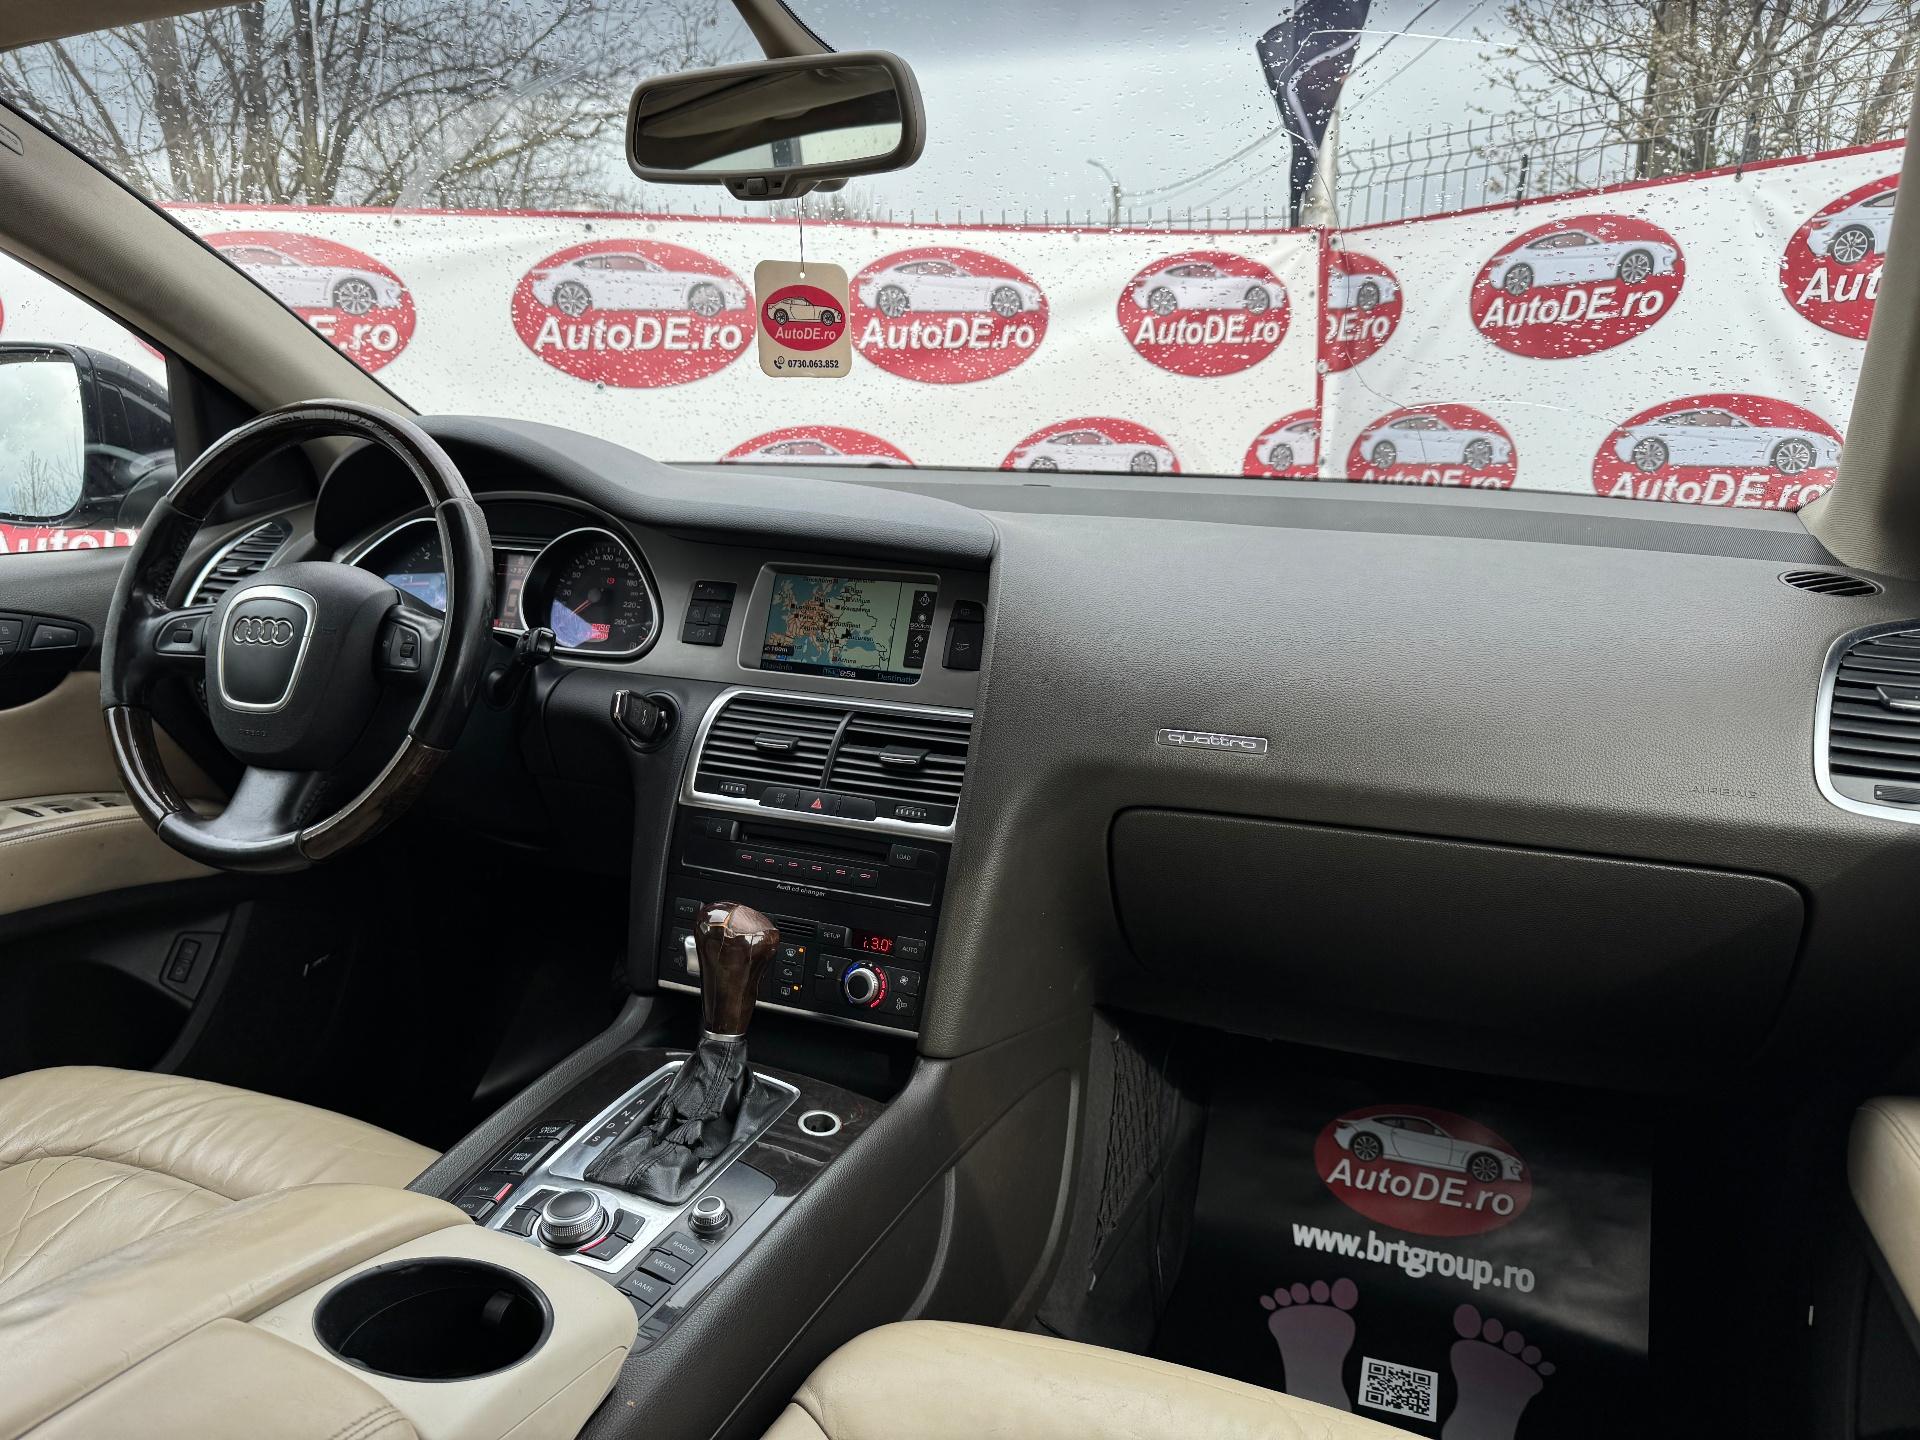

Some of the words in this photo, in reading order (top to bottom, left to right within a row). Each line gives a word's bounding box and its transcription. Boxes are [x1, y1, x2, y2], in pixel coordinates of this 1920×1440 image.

[1480, 286, 1664, 328] AutoDE.ro
[534, 316, 743, 351] AutoDE.ro
[775, 326, 837, 340] AutoDE.ro
[859, 317, 1035, 350] AutoDE.ro
[1133, 315, 1280, 346] AutoDE.ro
[788, 359, 840, 369] 0730.063.852
[1167, 733, 1257, 748] quattro
[1326, 1158, 1515, 1217] AutoDE.ro
[672, 1240, 695, 1255] RADIO
[1292, 1223, 1536, 1293] www.brtgroup.ro
[653, 1257, 676, 1273] MEDIA
[632, 1278, 654, 1293] NAME
